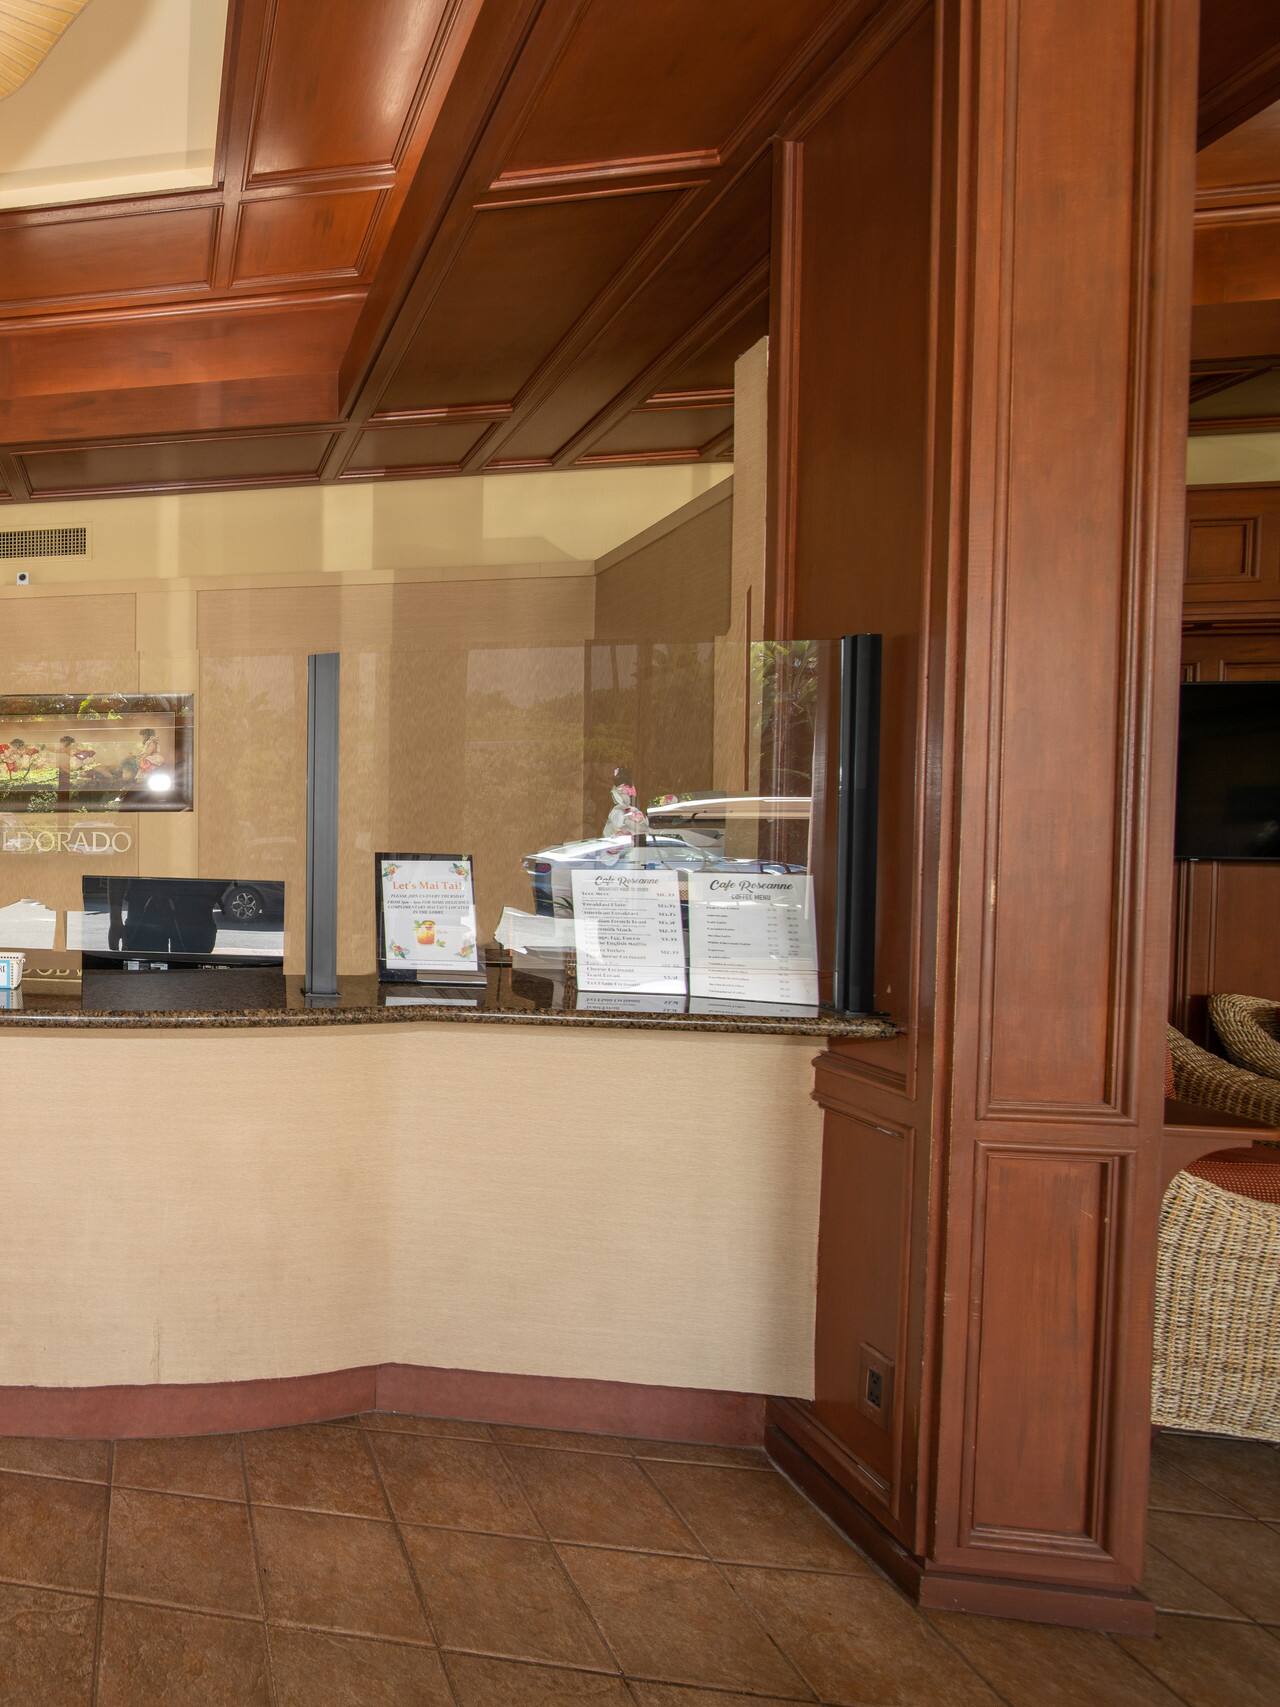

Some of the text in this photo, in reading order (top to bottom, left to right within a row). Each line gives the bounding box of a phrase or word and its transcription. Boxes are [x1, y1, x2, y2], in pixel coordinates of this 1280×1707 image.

[392, 881, 462, 890] Let's Mai Tai!
[709, 879, 793, 893] Cafe Roseanne
